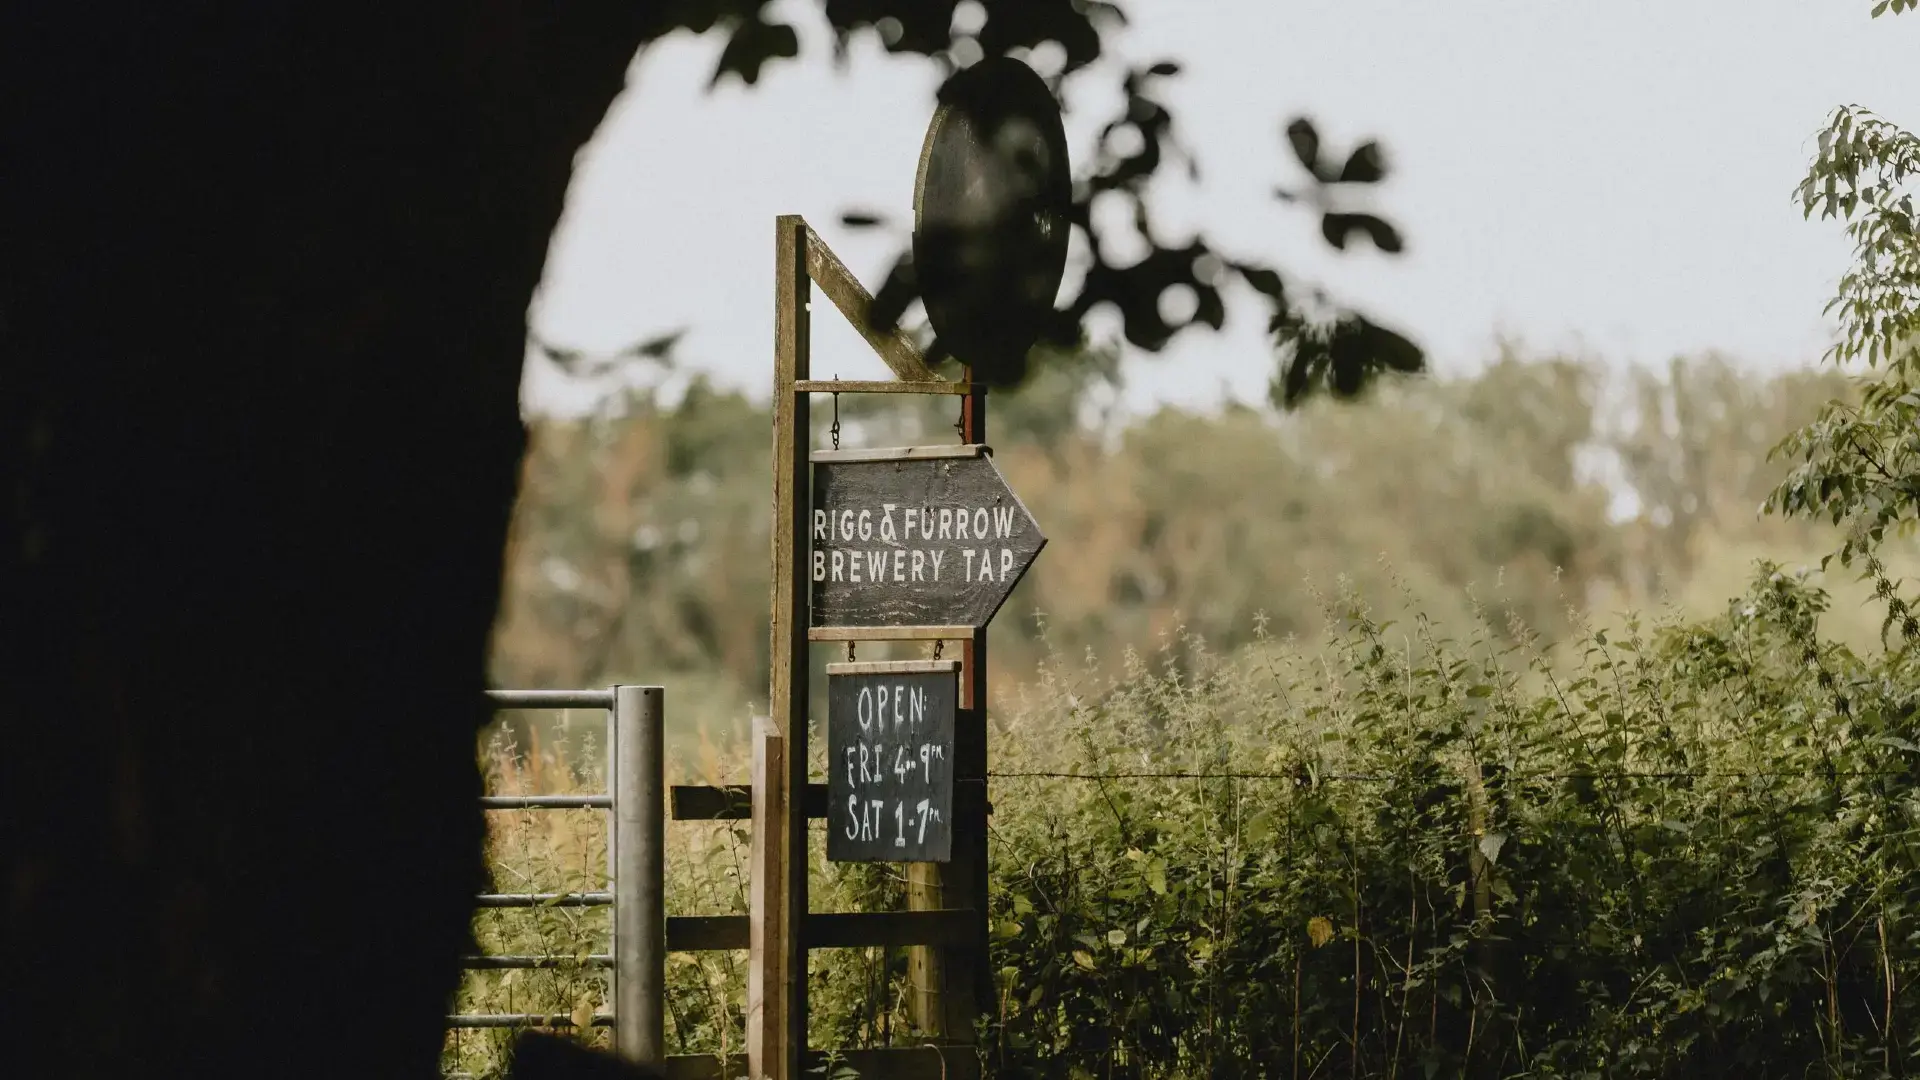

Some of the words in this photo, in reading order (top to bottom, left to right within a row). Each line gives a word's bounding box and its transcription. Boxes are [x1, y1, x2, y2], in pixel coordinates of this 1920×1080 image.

[814, 509, 872, 541] RIGG
[880, 504, 897, 540] &
[904, 506, 1014, 540] FURROW
[813, 550, 944, 582] BREWERY
[963, 549, 1014, 582] TAP
[846, 742, 883, 788] FRI
[846, 794, 884, 841] SAT
